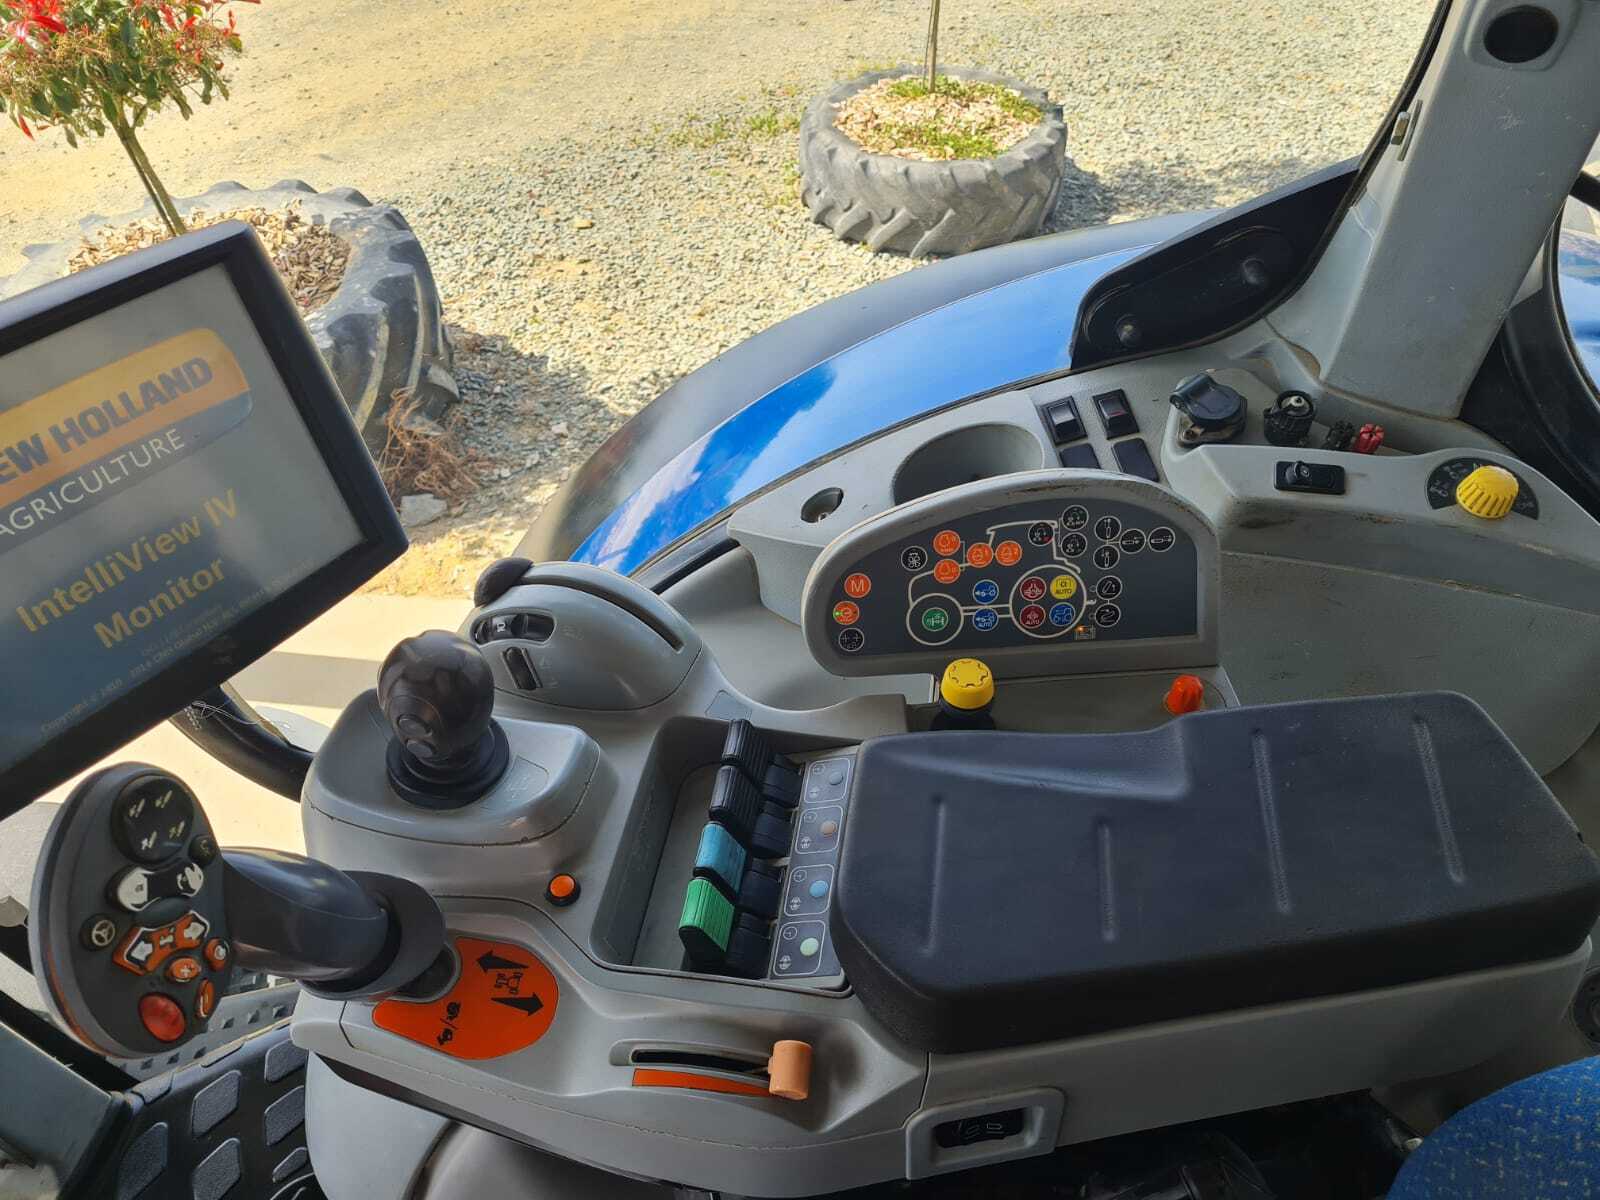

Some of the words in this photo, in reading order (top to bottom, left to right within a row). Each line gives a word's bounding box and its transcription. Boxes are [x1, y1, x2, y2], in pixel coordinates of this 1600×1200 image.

[48, 356, 213, 454] HOLLAND
[0, 428, 185, 536] AGRICULTURE
[16, 515, 202, 633] IntelliView
[203, 487, 238, 528] IV
[93, 558, 226, 649] Monitor
[850, 580, 865, 593] M
